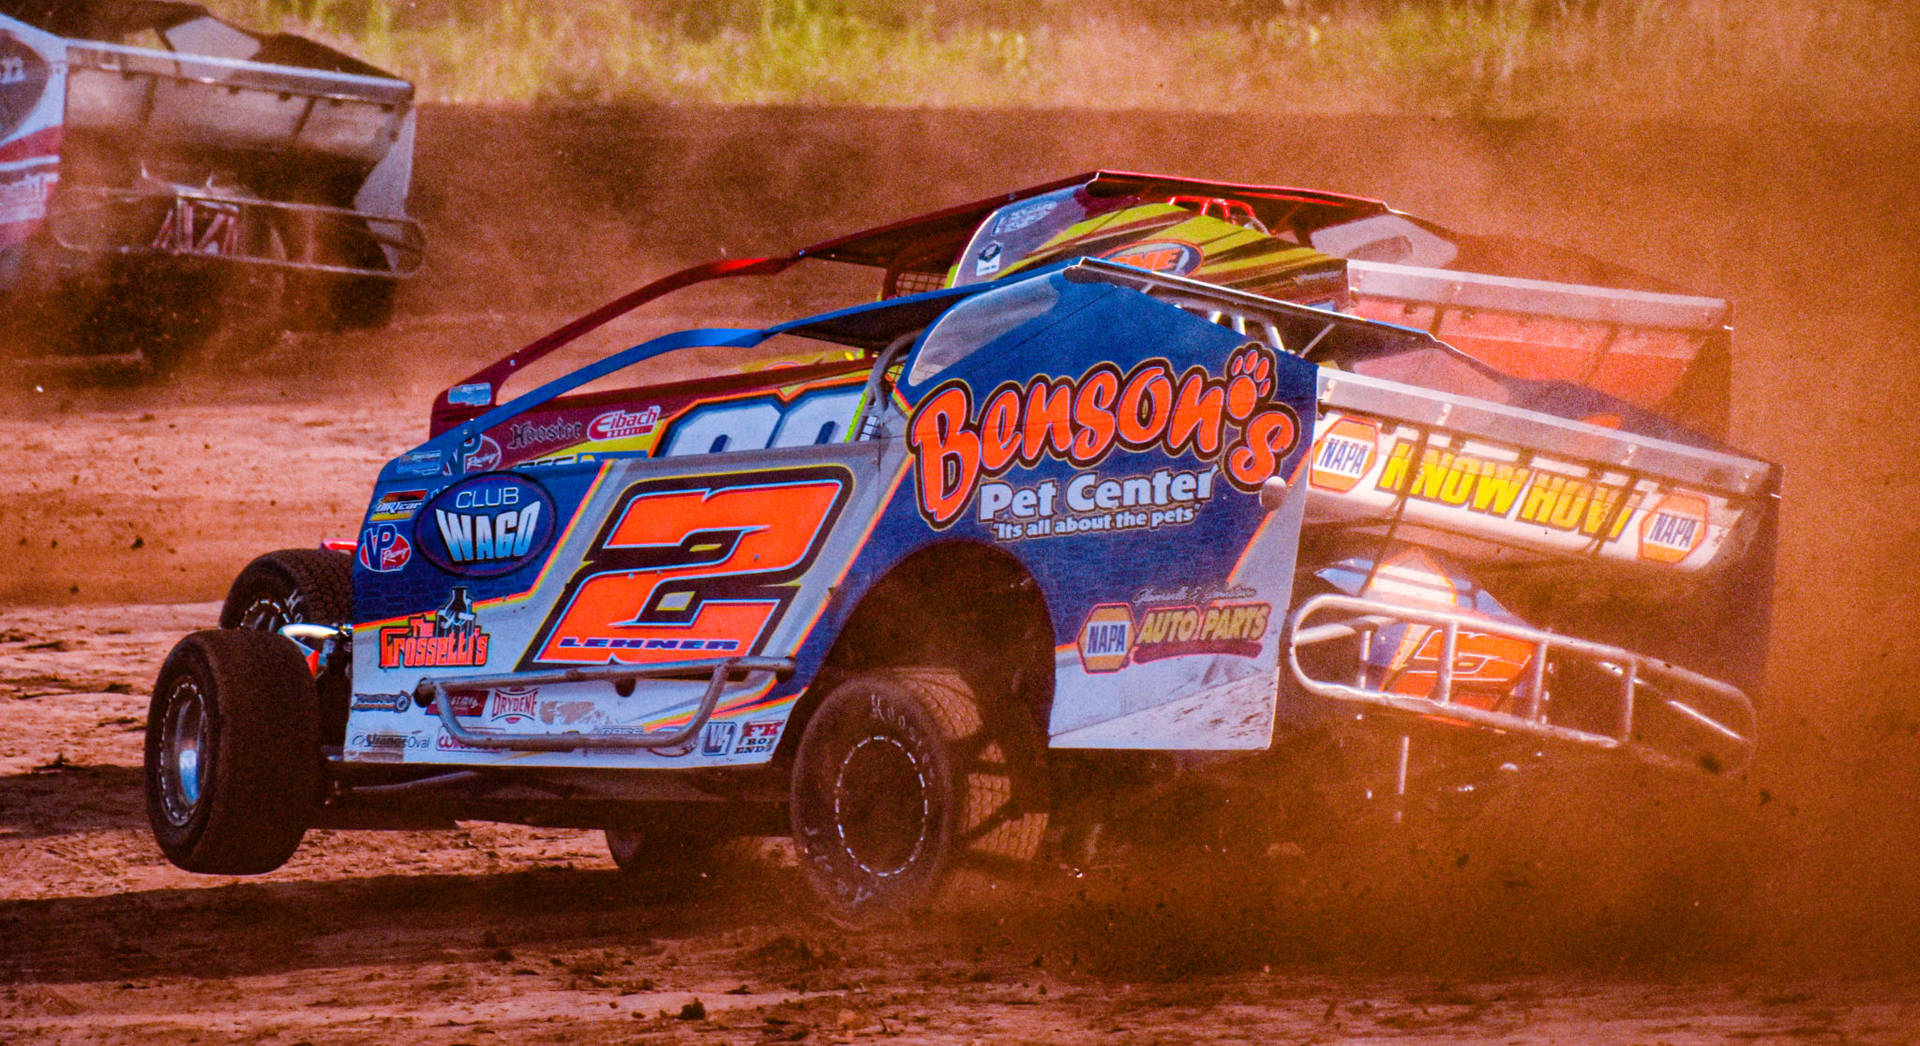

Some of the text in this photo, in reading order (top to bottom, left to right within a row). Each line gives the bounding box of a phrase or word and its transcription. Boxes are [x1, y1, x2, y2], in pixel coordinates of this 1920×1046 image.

[508, 417, 582, 449] Hoosier
[592, 406, 659, 434] Eibach
[911, 350, 1298, 523] Benson's
[1319, 437, 1369, 475] NAPA
[979, 463, 1220, 521] Pet Center
[1377, 441, 1534, 517] KNOW
[455, 486, 519, 509] CLUB
[435, 500, 542, 563] WAGO
[1027, 519, 1051, 536] all
[1055, 512, 1113, 534] about
[1116, 511, 1147, 528] the
[1649, 514, 1698, 547] NAPA
[363, 523, 398, 571] VP
[530, 478, 843, 665] 2
[1086, 623, 1128, 654] NAPA
[1135, 604, 1270, 644] AUTO PARTS
[558, 636, 740, 651] LEHNER
[492, 688, 538, 717] DRYDENE
